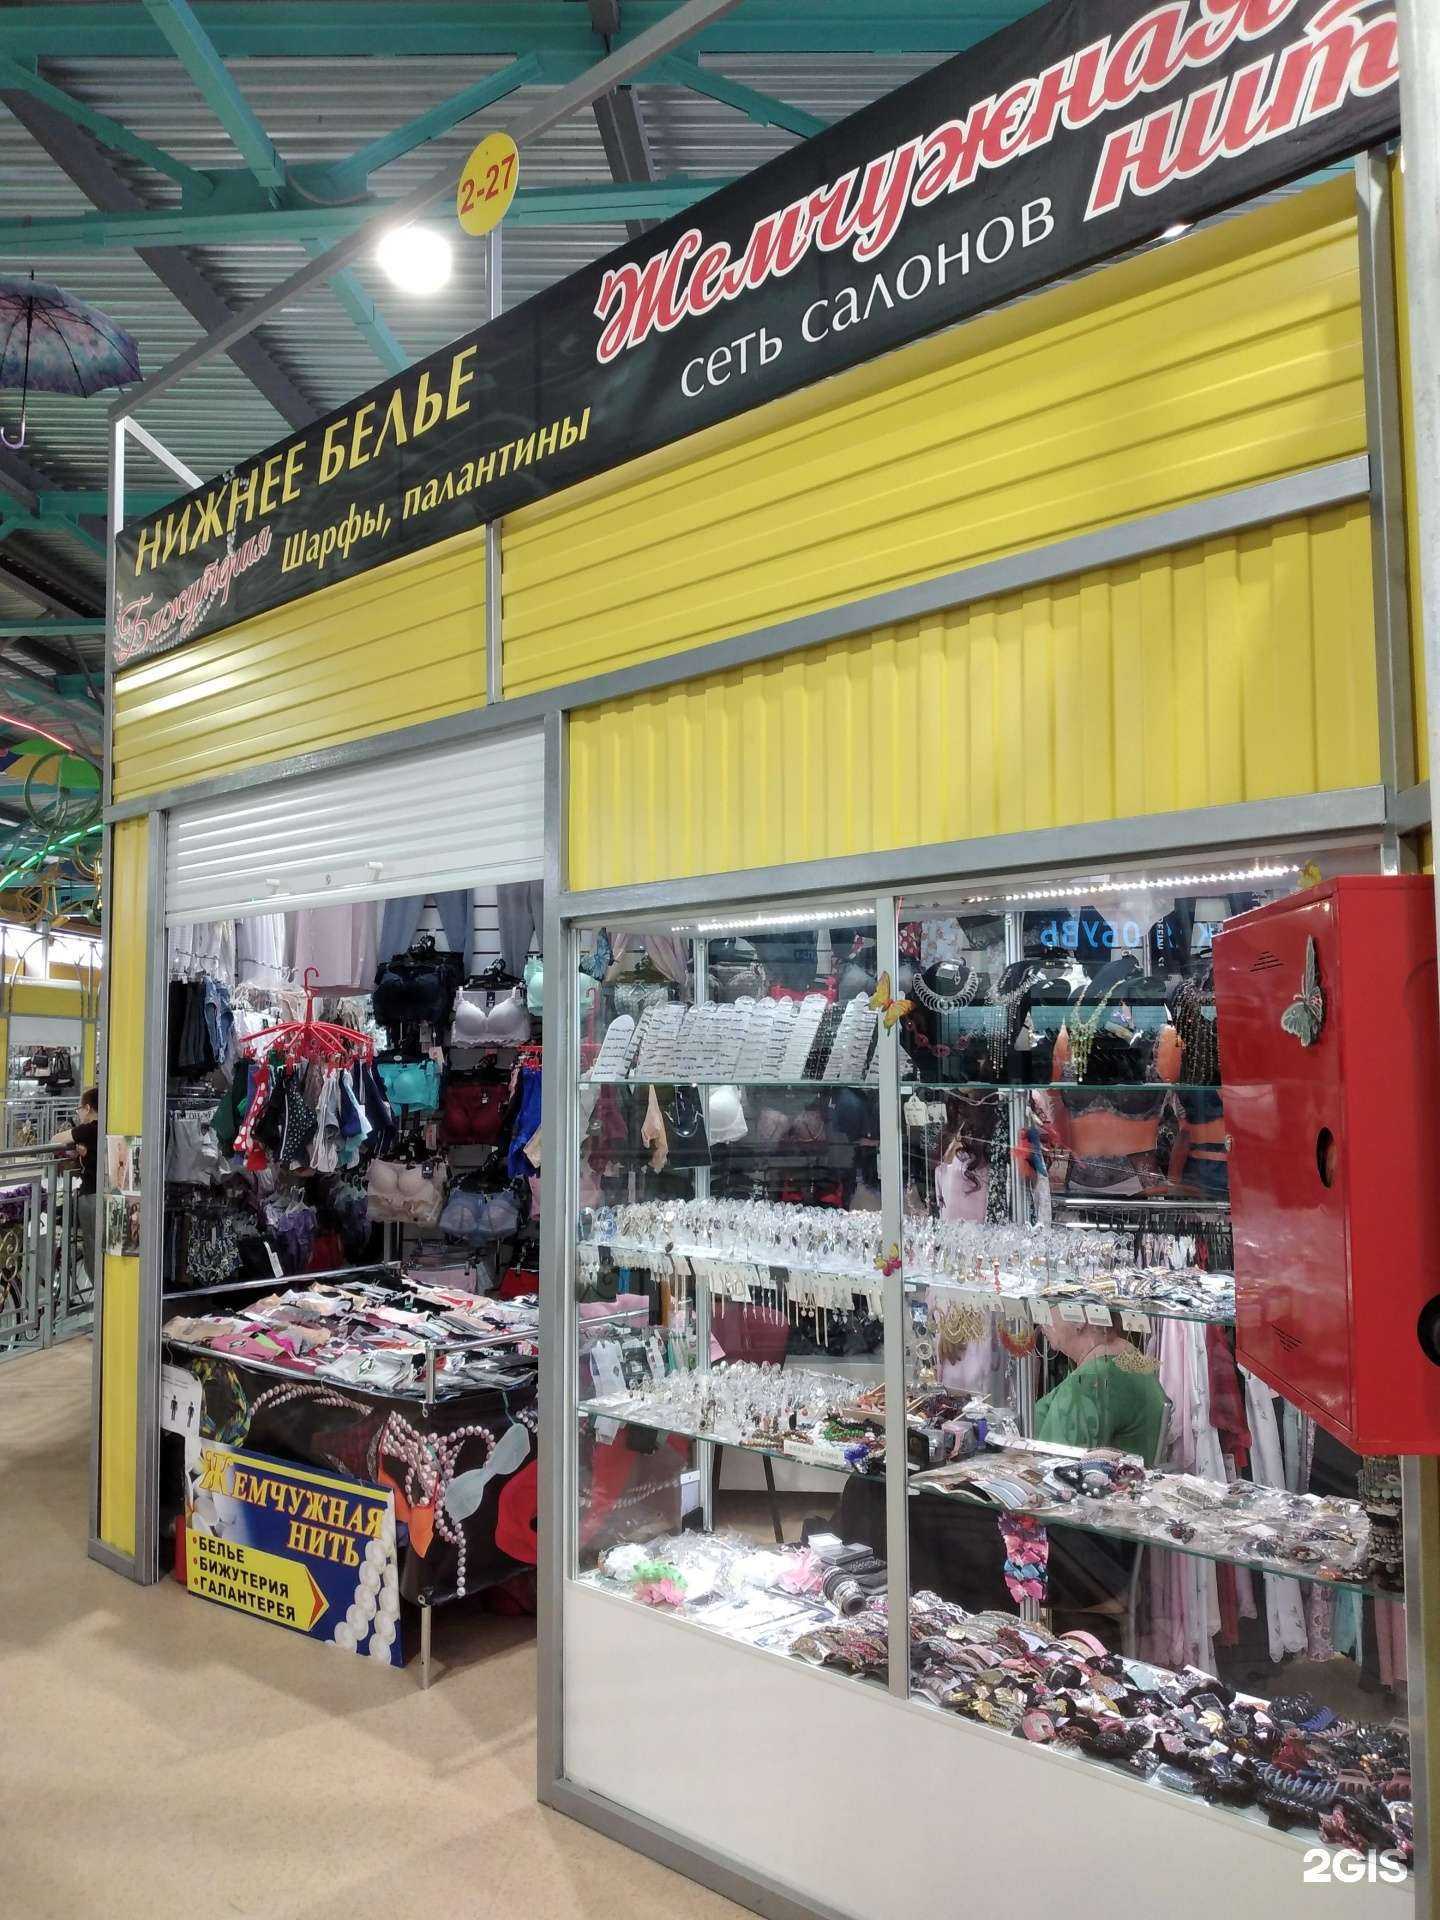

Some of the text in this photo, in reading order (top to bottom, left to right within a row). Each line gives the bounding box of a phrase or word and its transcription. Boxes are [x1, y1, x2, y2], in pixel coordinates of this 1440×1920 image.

[1084, 0, 1400, 220] нит
[461, 152, 516, 216] 2-27
[681, 196, 1055, 398] сеть салонов
[134, 344, 479, 576] НИЖНЕЕ БЕЛЬЕ
[281, 406, 591, 574] Шарфы, палантины
[115, 524, 272, 665] Бижутерия
[199, 1449, 386, 1540] ЖЕМЧУЖНАЯ
[199, 1535, 245, 1564] БЕЛЬЕ
[199, 1556, 289, 1599] БИЖУТЕРИЯ
[286, 1519, 361, 1568] НИТЬ
[199, 1576, 296, 1622] ГАЛАНТЕРЕЯ
